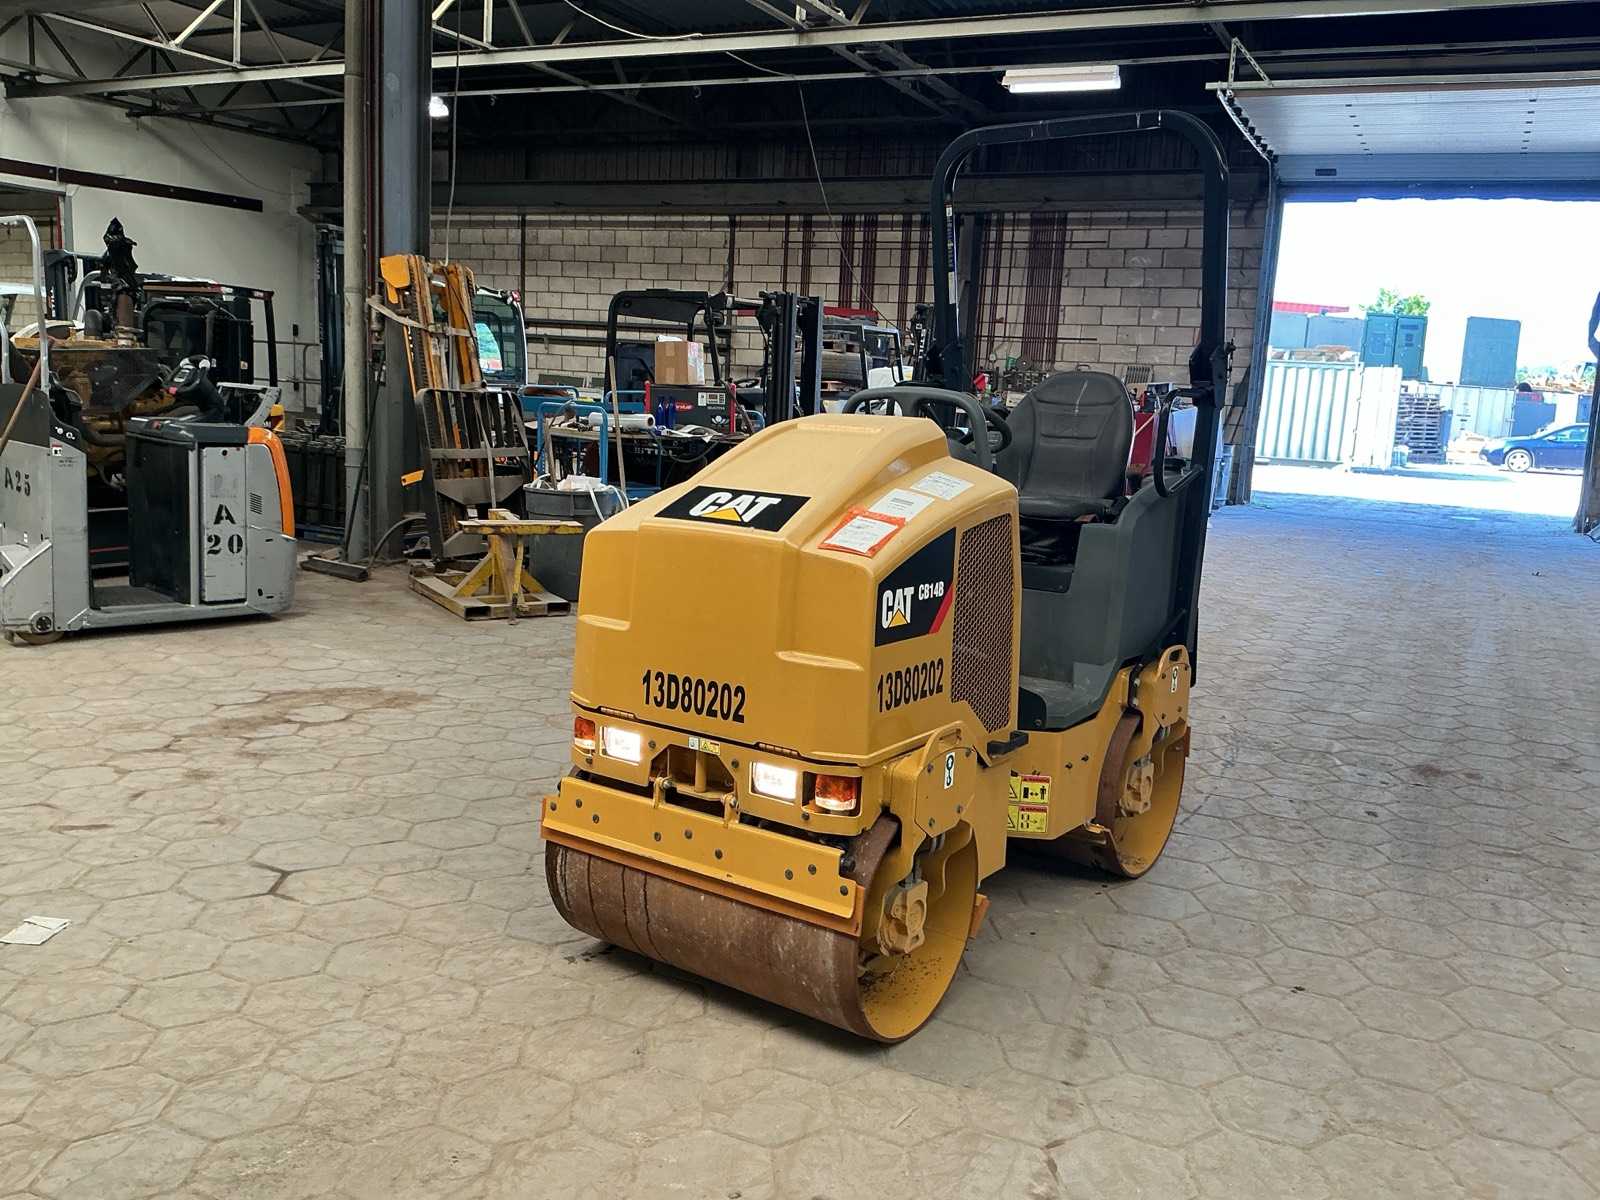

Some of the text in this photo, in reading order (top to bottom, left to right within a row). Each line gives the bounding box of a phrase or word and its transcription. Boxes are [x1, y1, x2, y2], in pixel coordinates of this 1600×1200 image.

[4, 467, 31, 496] A25
[213, 504, 236, 525] A
[689, 492, 782, 522] CAT
[207, 533, 243, 555] 20
[881, 581, 945, 629] CAT CB14B
[642, 669, 746, 723] 13D80202
[877, 657, 944, 713] 13D80202
